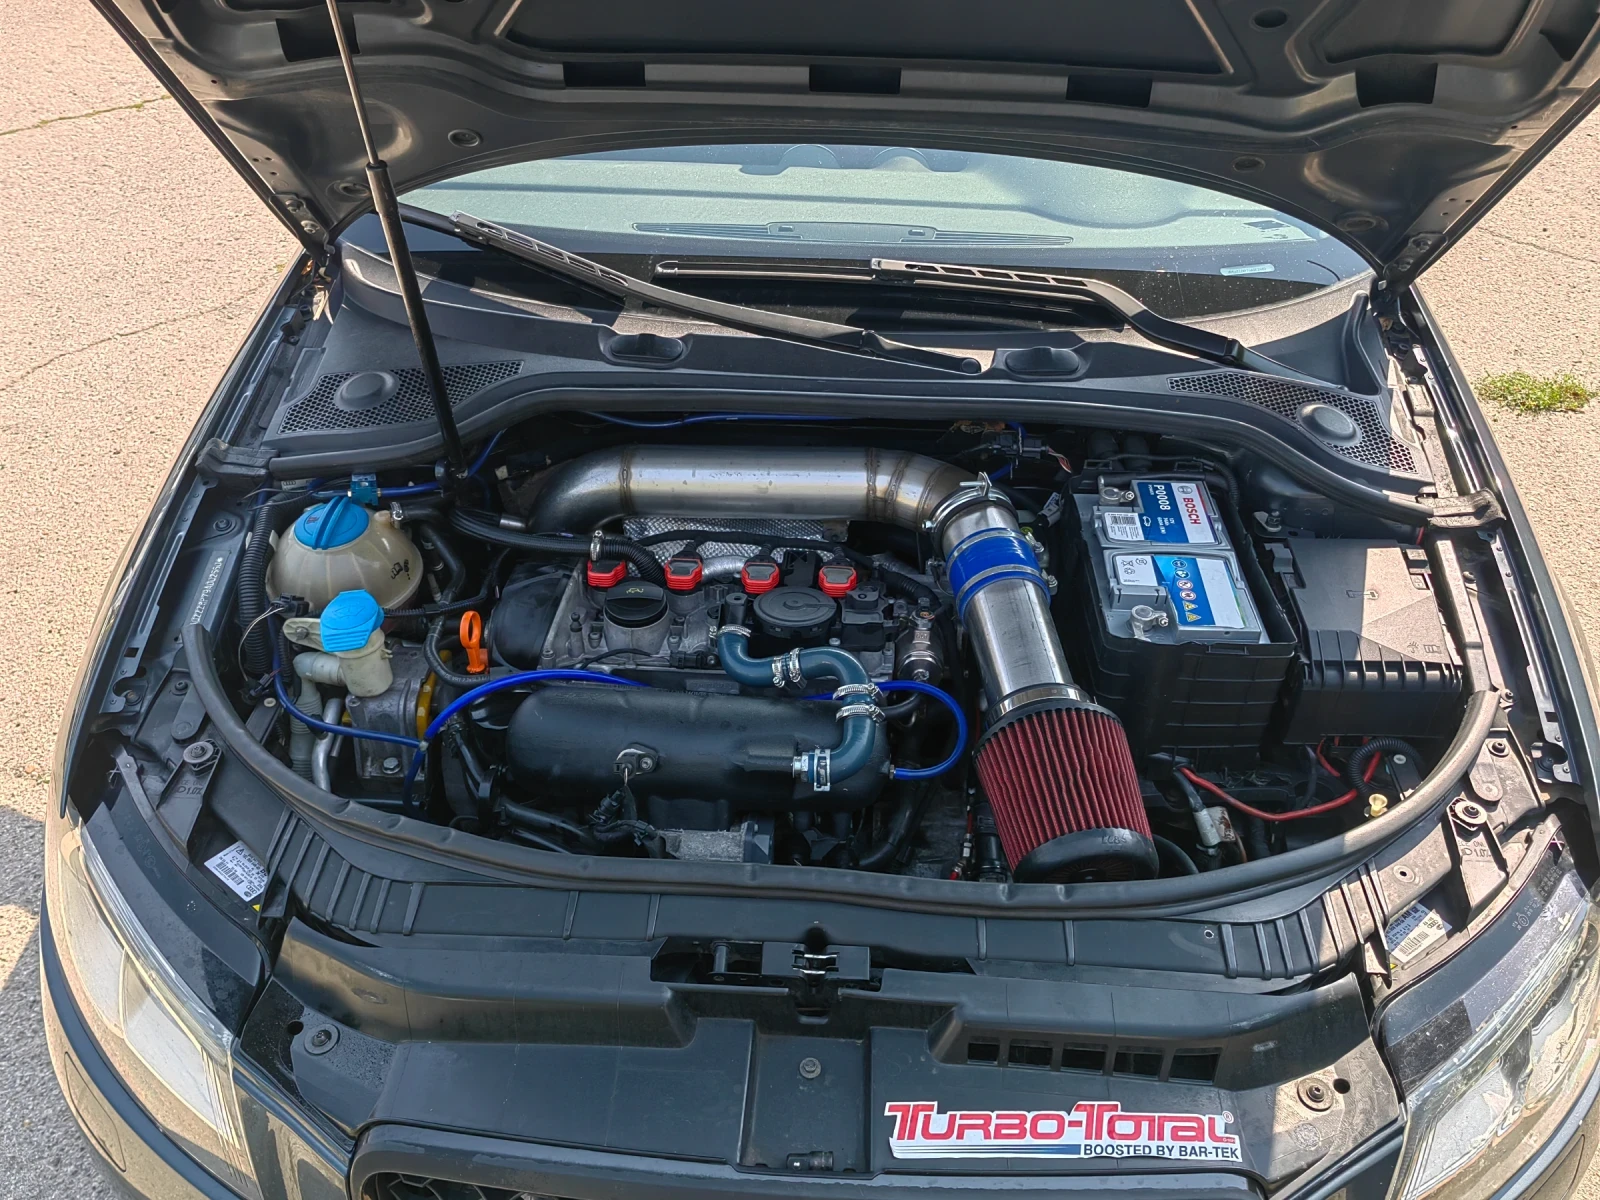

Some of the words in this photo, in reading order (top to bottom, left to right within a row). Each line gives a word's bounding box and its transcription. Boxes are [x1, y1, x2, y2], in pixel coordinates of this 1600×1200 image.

[1153, 484, 1171, 510] P0008
[1183, 497, 1202, 524] BOSCH
[1083, 1143, 1152, 1156] BOOSTED
[1156, 1144, 1175, 1157] BY
[1179, 1145, 1239, 1160] BAR-TEK
